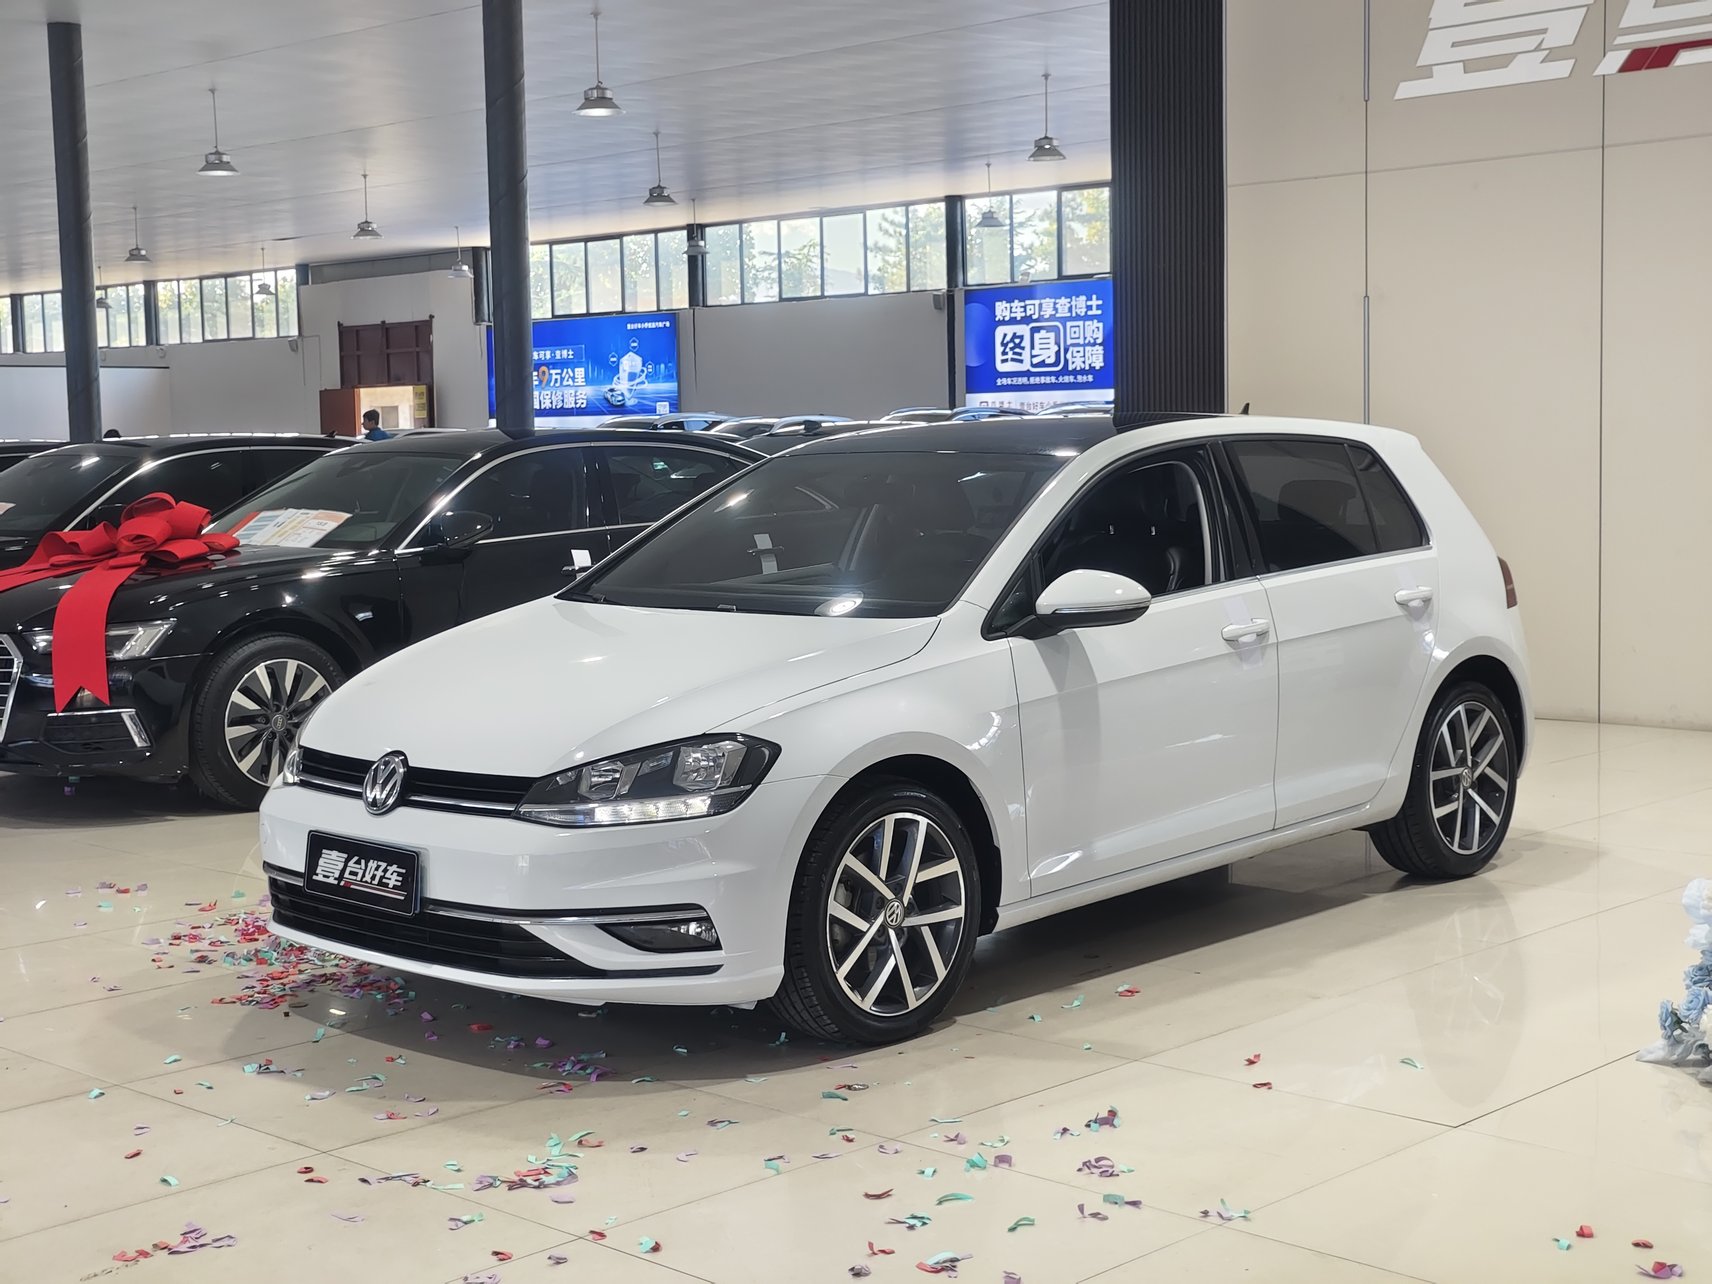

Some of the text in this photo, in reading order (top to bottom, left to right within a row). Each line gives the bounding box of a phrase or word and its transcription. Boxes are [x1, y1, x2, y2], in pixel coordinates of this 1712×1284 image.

[995, 294, 1103, 321] 购车可享查博士
[1066, 319, 1104, 345] 回购
[1000, 329, 1059, 365] 终身
[1066, 345, 1105, 371] 保障
[312, 849, 407, 889] 壹台好车
